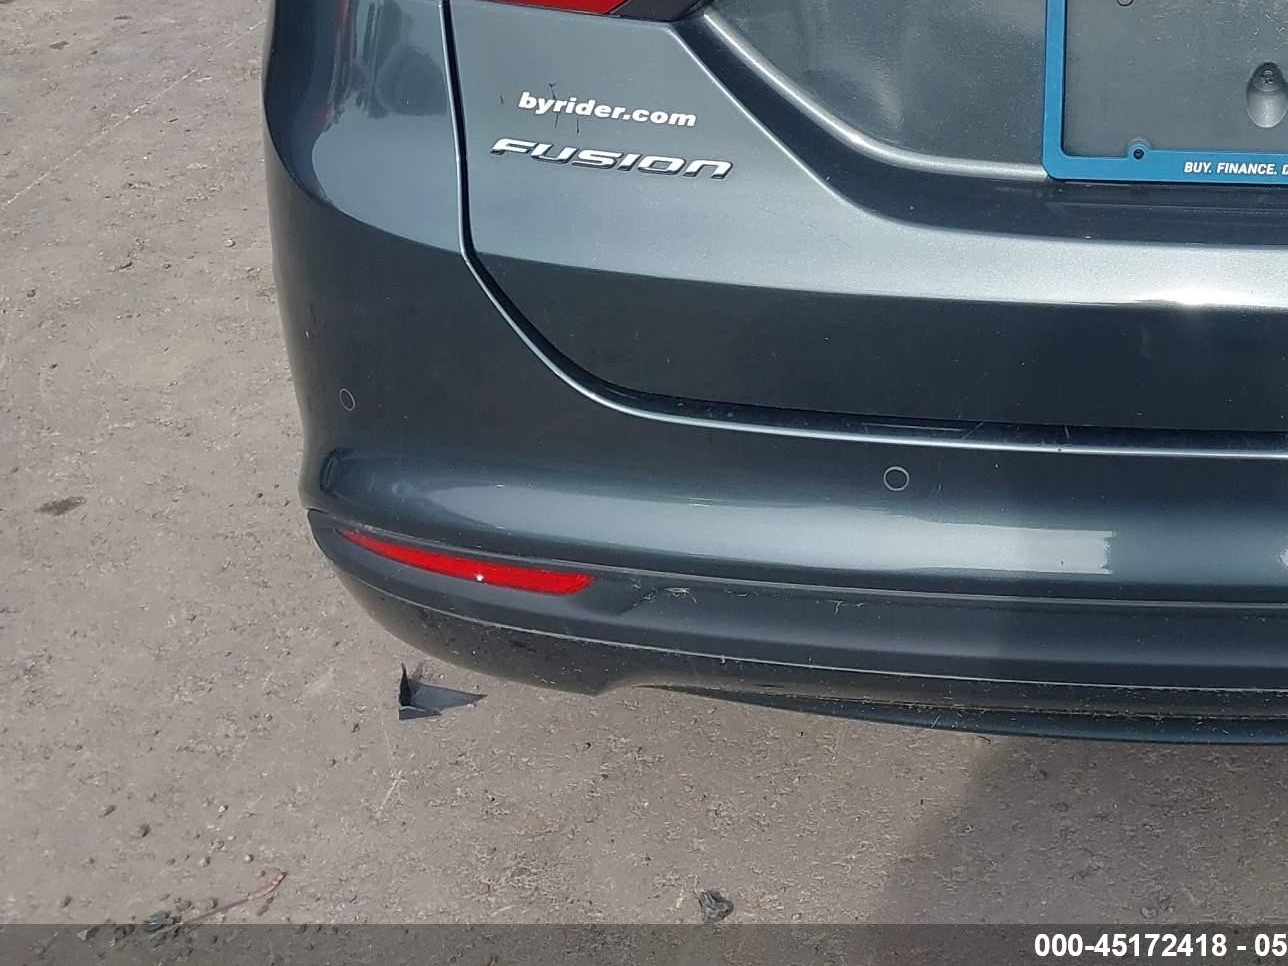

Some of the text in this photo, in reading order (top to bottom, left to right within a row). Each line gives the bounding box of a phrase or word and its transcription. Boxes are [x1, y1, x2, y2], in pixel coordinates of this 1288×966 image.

[518, 91, 697, 127] byrider.com
[490, 138, 734, 180] FUSION
[1184, 161, 1212, 173] BUY.
[1216, 162, 1277, 175] FINANCE.
